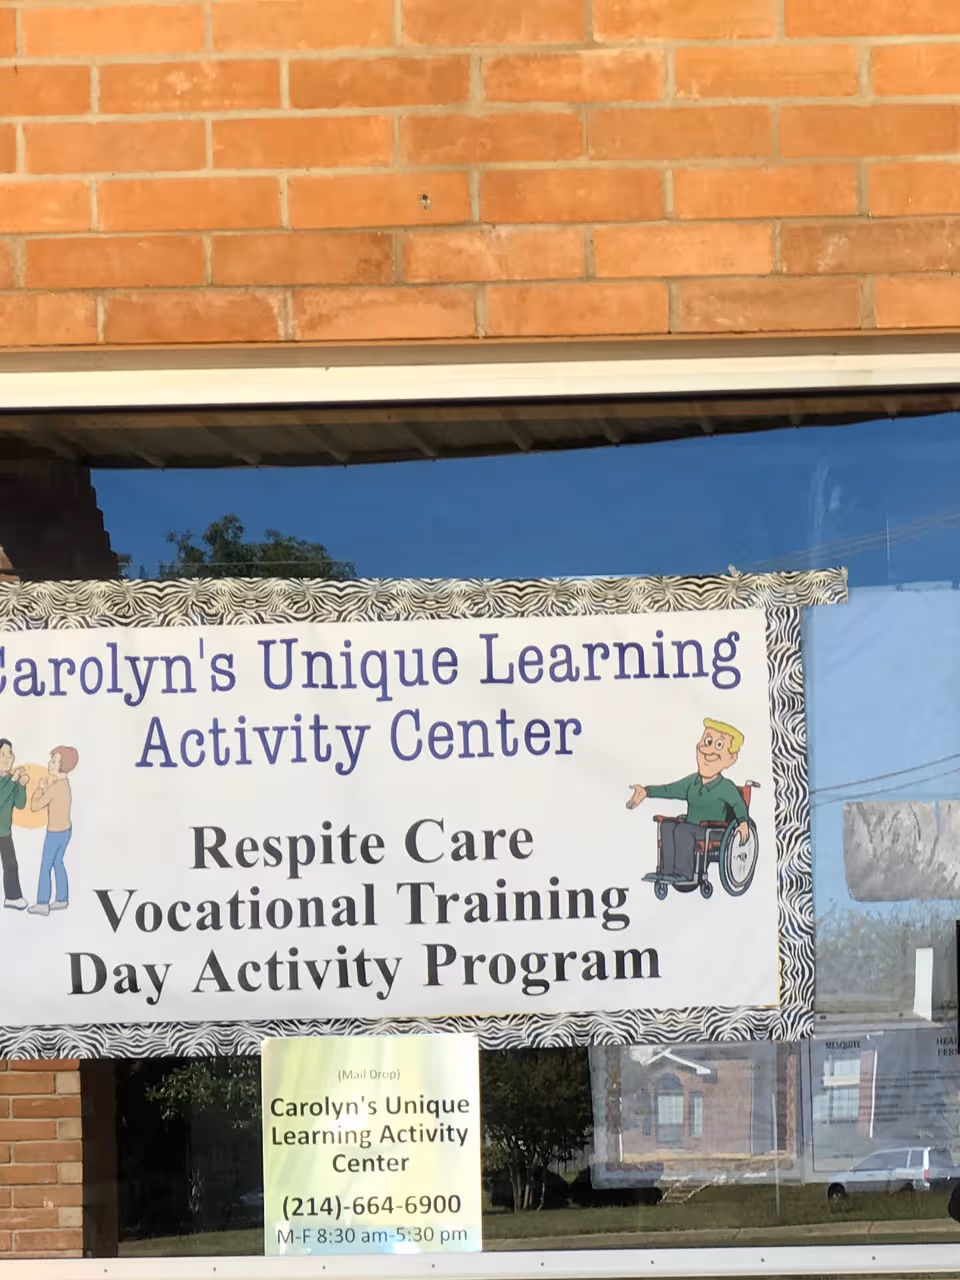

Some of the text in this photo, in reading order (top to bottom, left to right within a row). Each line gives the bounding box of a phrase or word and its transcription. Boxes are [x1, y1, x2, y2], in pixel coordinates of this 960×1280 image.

[258, 637, 459, 702] Unique
[480, 630, 742, 689] Learning
[134, 707, 582, 775] Activity Center
[190, 818, 534, 879] Respite Care
[92, 876, 631, 934] Vocational Training
[68, 942, 661, 1006] Day Activity Program
[337, 1067, 401, 1083] (Mail Drop)
[270, 1094, 470, 1120] Carolyn's Unique
[271, 1123, 469, 1149] Learning Activity
[332, 1153, 410, 1173] Center
[282, 1194, 462, 1221] (214)-664-6900
[277, 1228, 311, 1245] M-F
[317, 1228, 356, 1244] 8:30
[440, 1230, 468, 1245] pm
